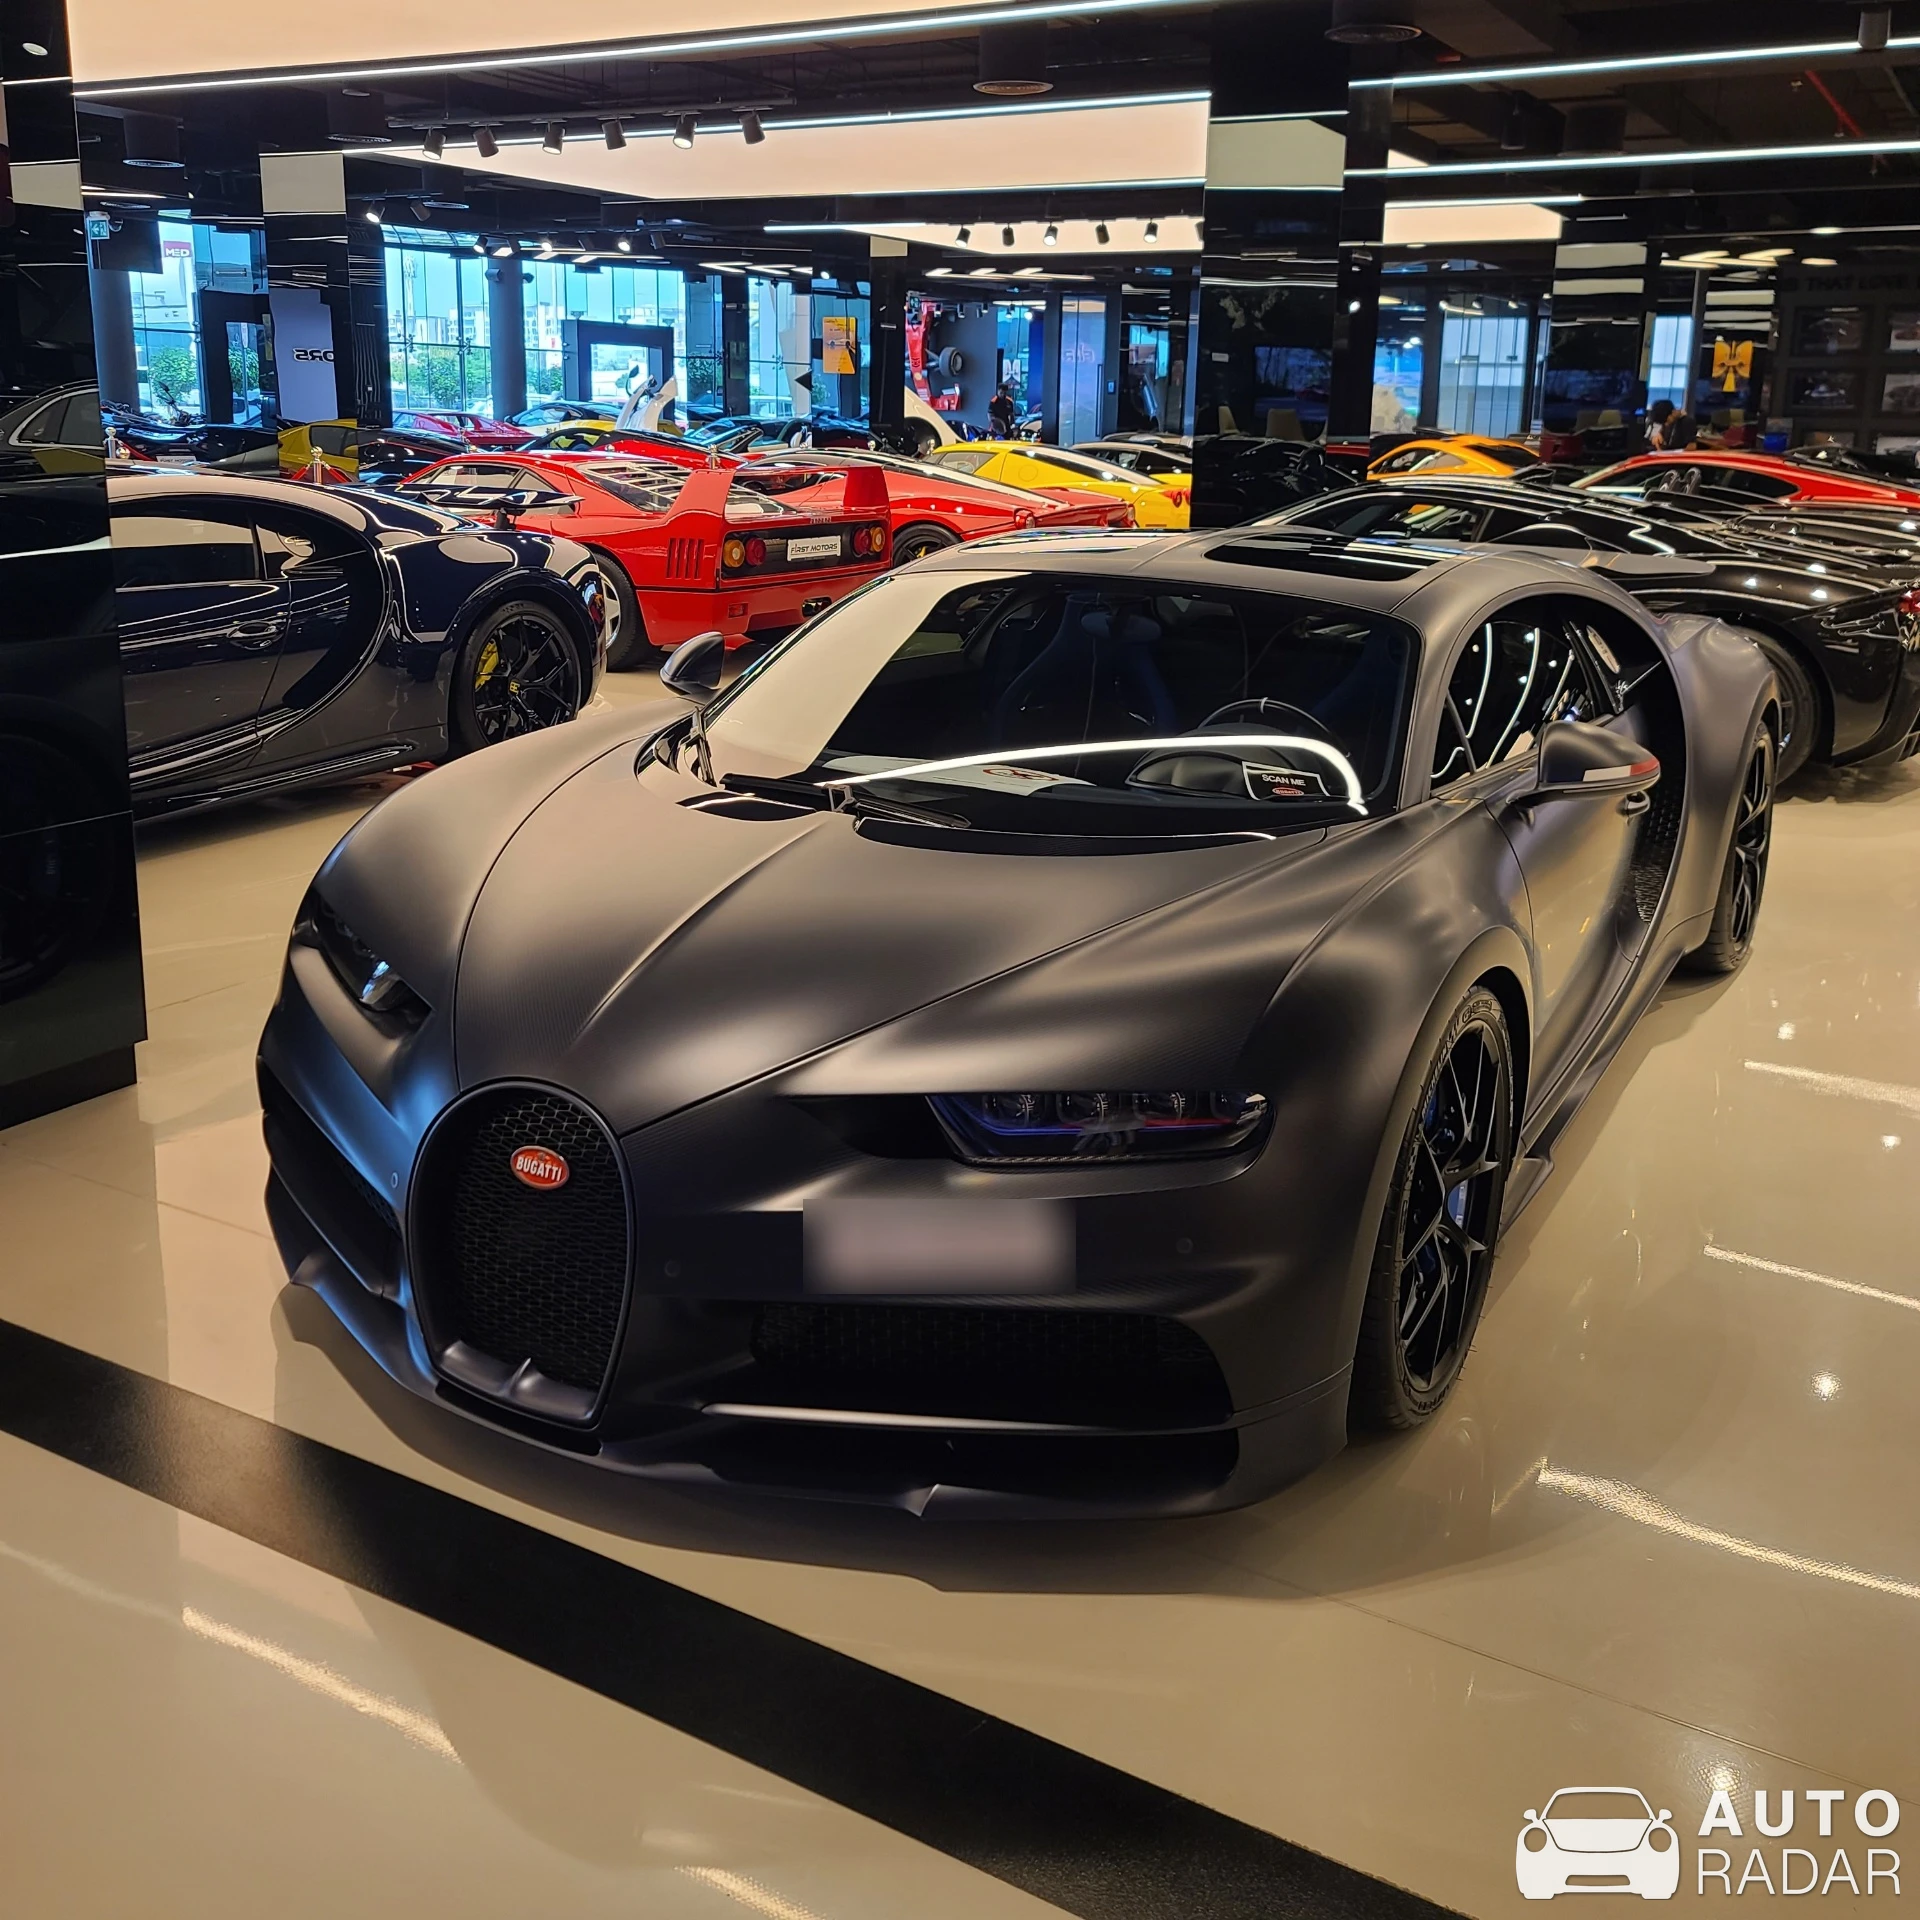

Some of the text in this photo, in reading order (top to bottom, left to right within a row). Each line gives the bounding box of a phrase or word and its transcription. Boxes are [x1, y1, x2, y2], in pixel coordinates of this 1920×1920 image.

[165, 247, 190, 257] MED
[791, 543, 838, 554] FIRST MOTORS
[1262, 774, 1307, 787] SCAN ME
[516, 1156, 562, 1182] BUGATTI
